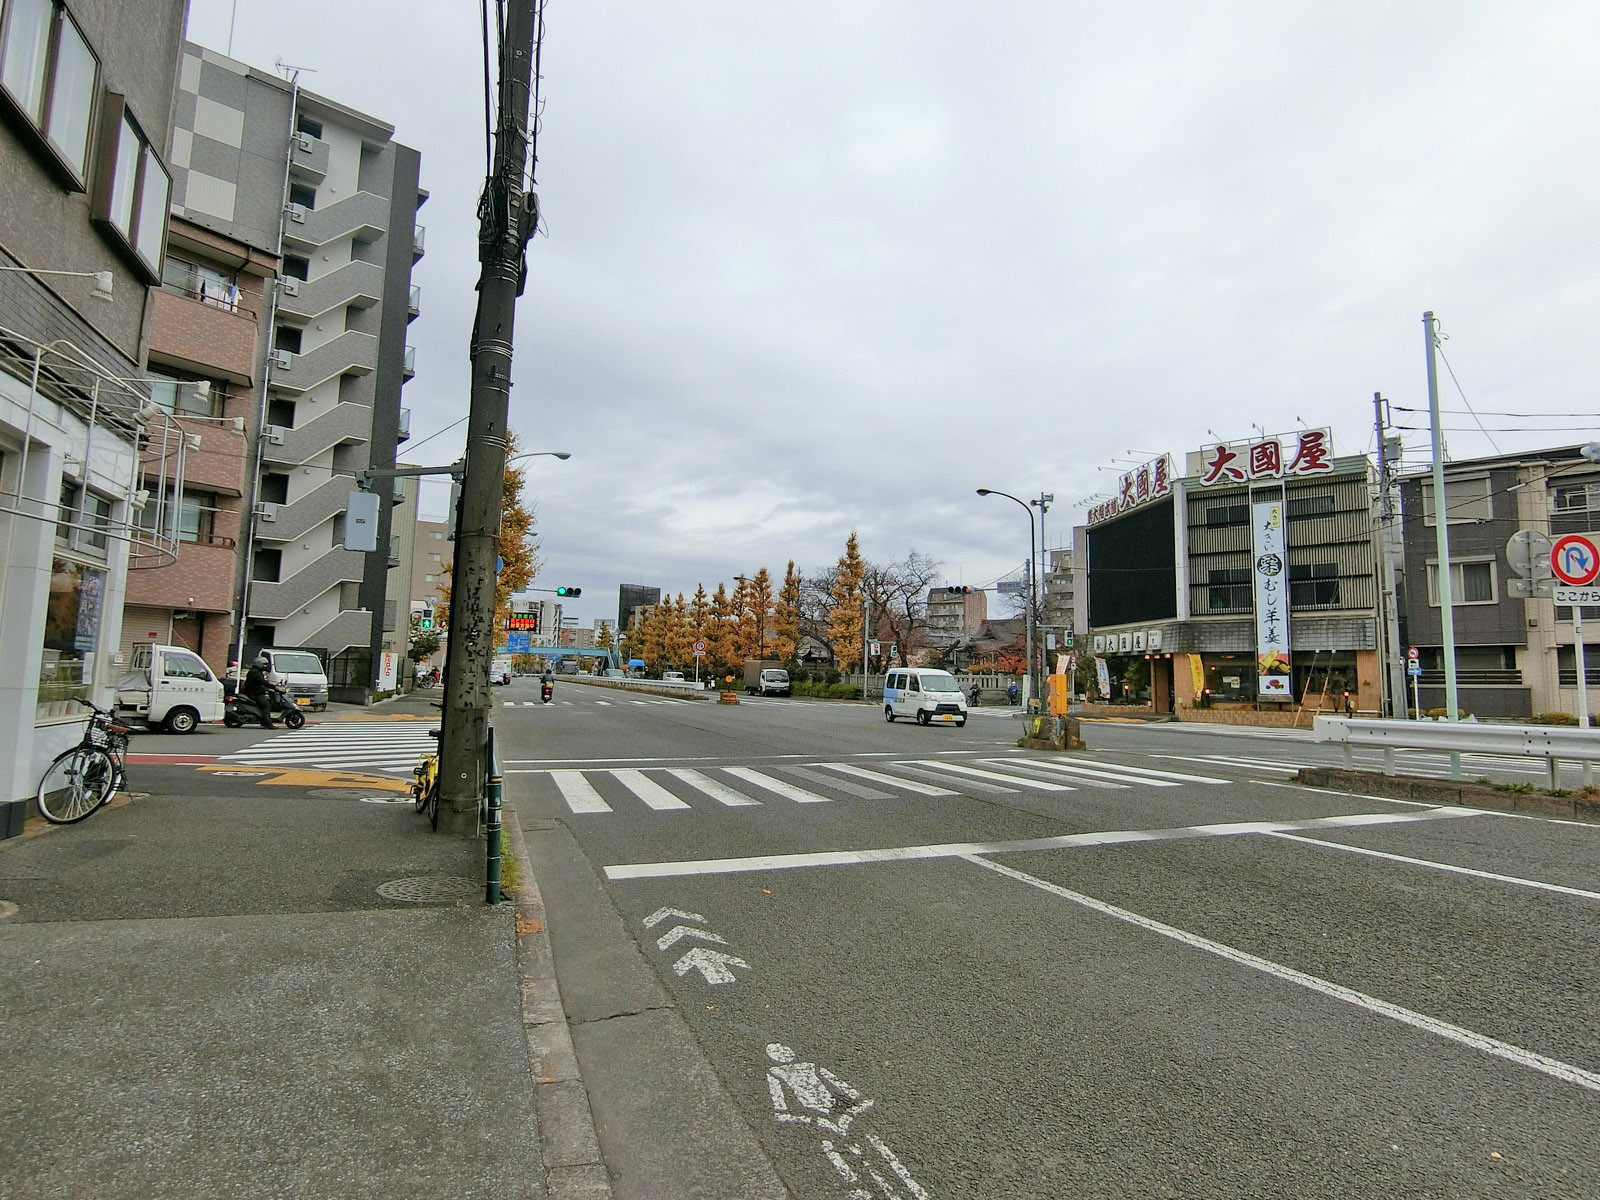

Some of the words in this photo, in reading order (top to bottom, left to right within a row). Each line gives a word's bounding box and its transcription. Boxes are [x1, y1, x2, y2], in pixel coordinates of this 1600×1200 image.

[1120, 457, 1169, 509] 大國屋
[1203, 431, 1331, 483] 大國屋
[1556, 591, 1600, 602] ここから
